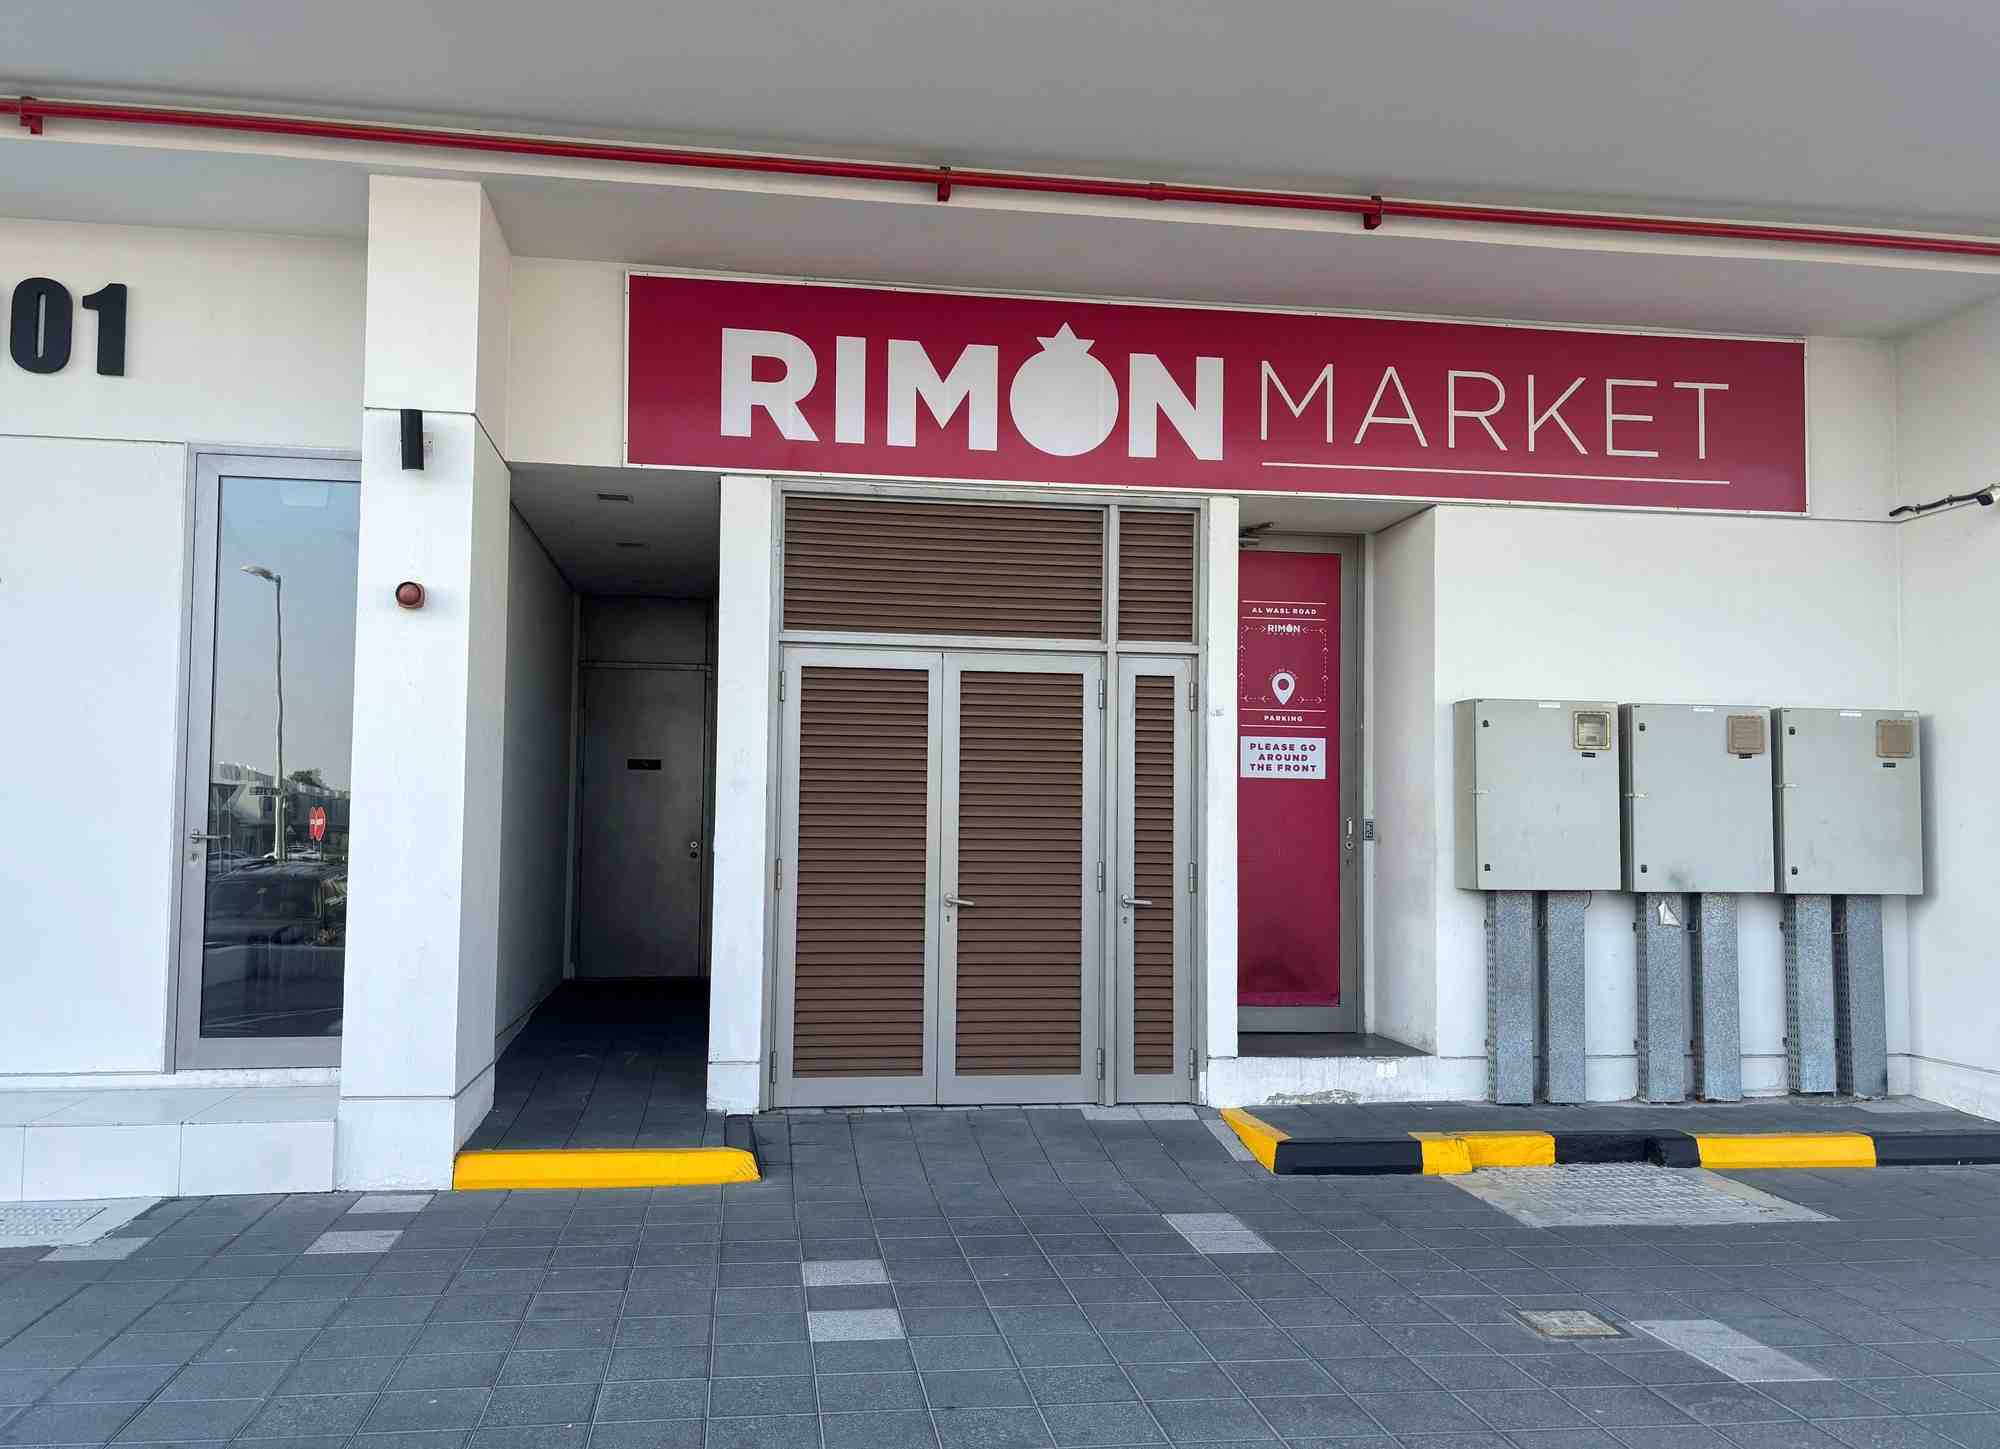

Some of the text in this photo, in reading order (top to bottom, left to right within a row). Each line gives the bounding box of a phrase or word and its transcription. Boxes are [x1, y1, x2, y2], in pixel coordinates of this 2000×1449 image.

[9, 277, 128, 377] 01
[719, 321, 1730, 461] RIMON MARKET
[1265, 607, 1290, 615] WASL
[1292, 608, 1318, 616] ROAD
[1267, 623, 1301, 634] RIMON
[1263, 715, 1304, 723] PARKING
[1249, 742, 1317, 753] PLEASE GO
[1257, 753, 1309, 763] AROUND
[1249, 763, 1317, 773] THE FRONT
